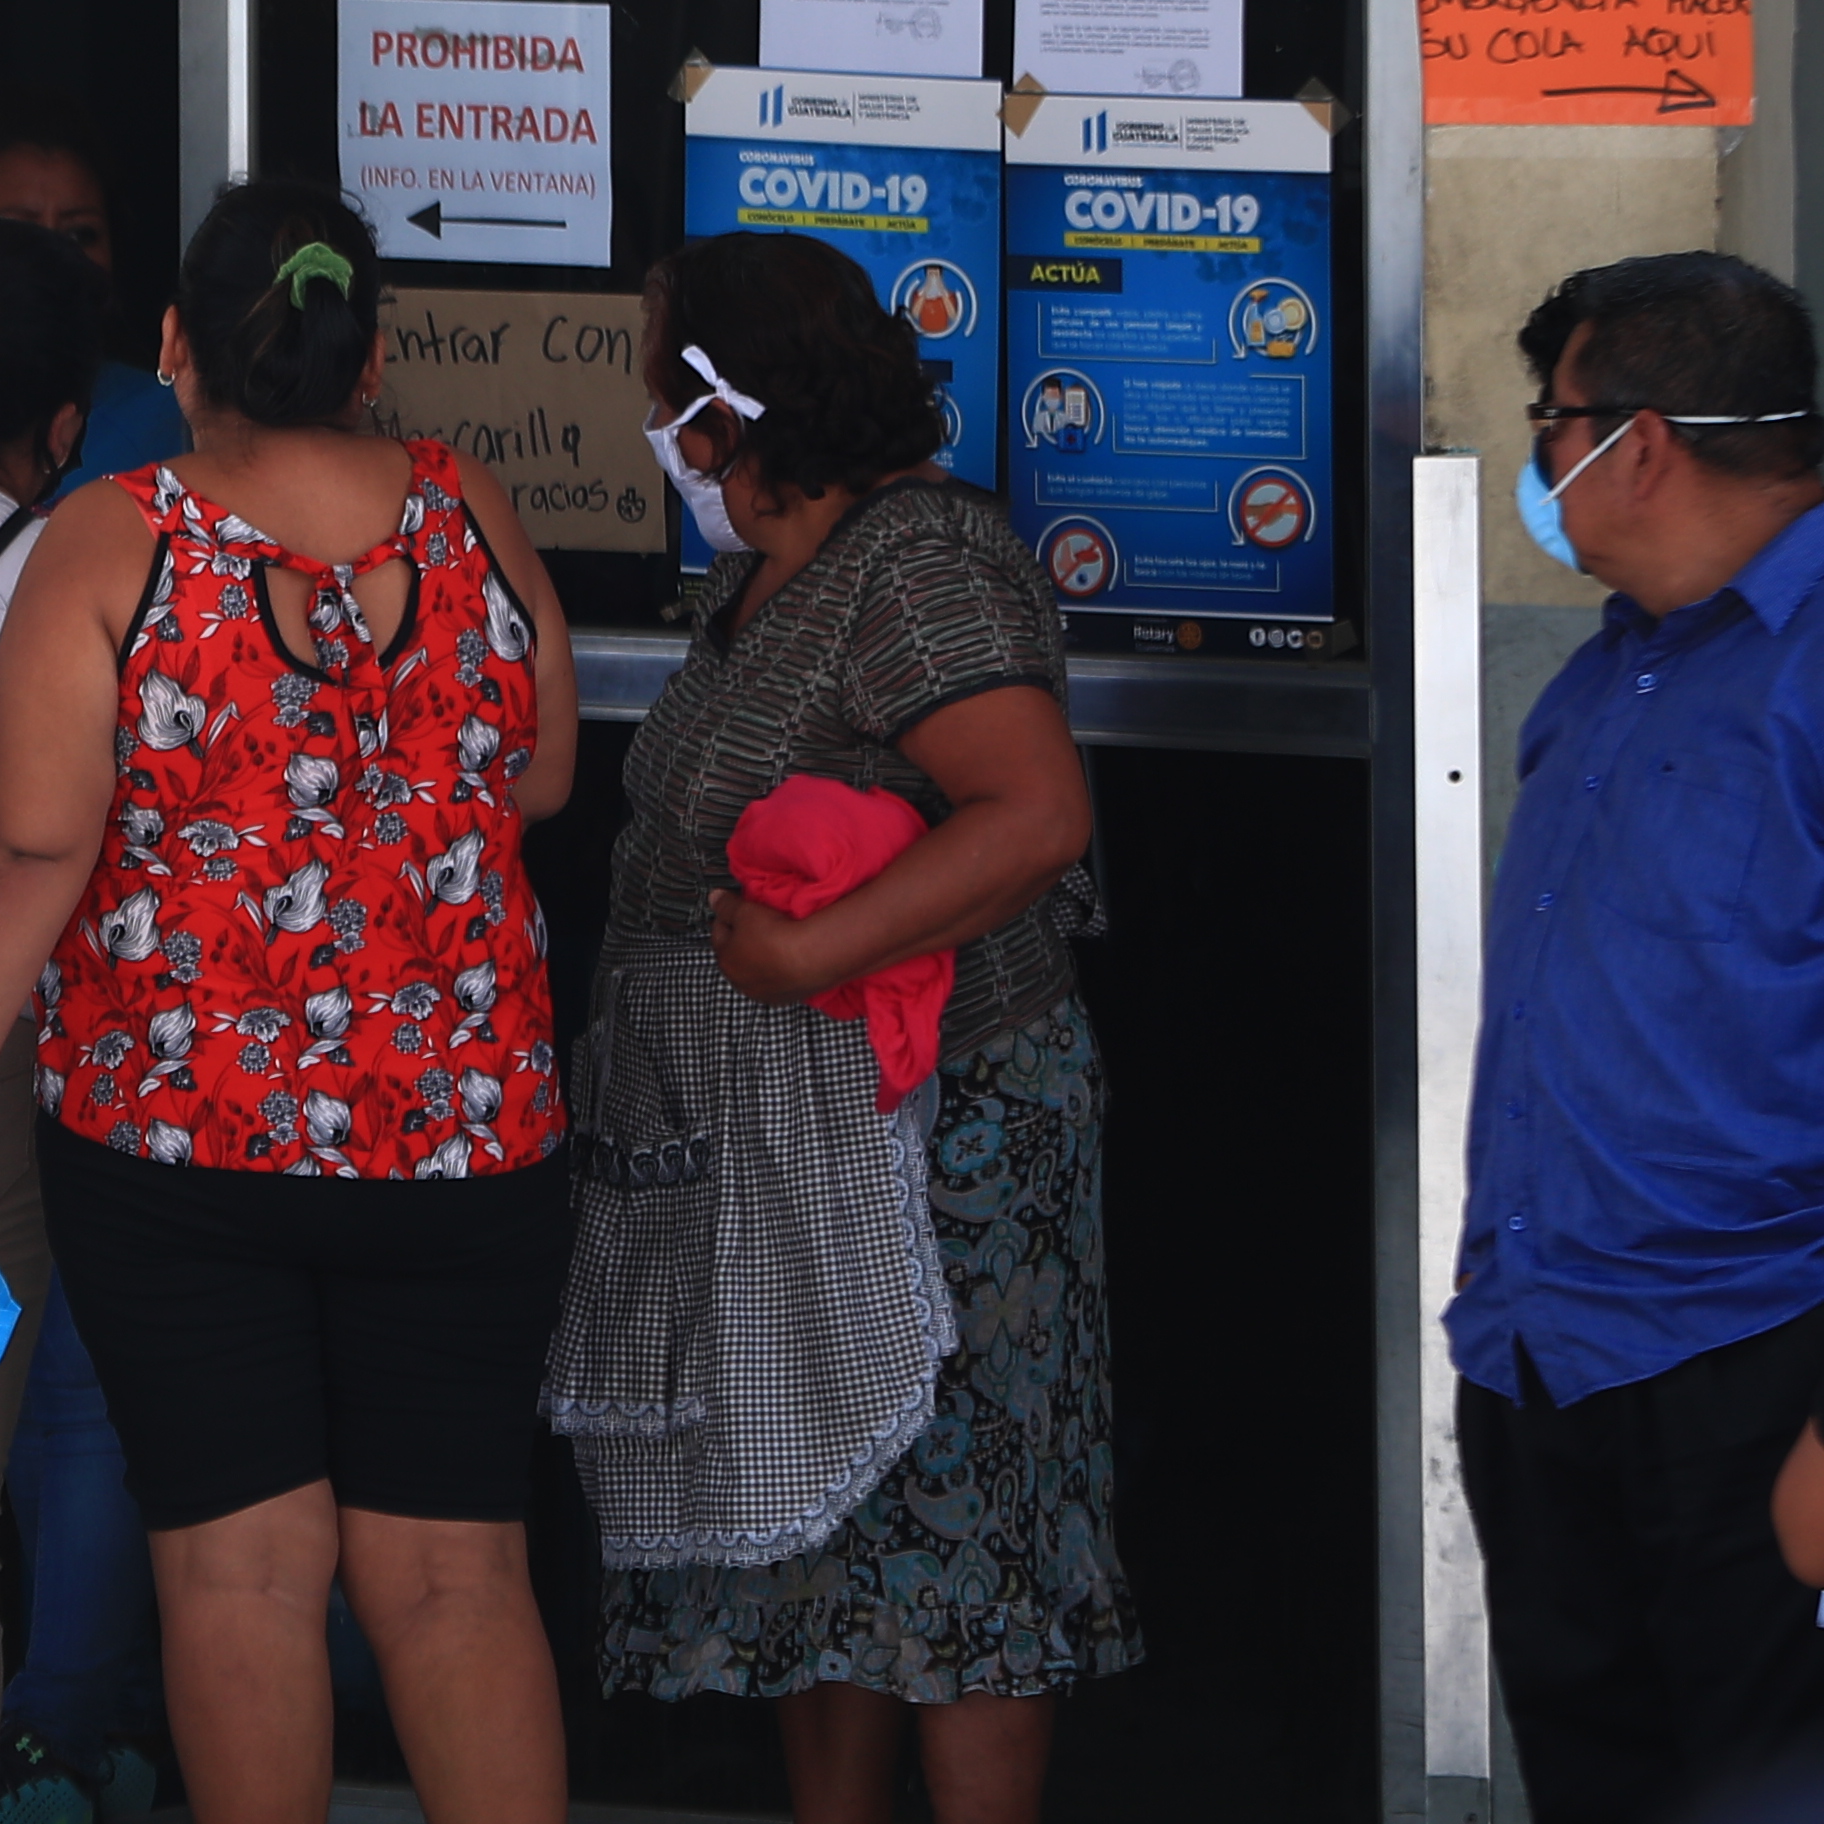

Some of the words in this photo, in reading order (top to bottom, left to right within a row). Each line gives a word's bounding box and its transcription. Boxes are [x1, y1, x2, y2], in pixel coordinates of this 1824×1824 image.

[371, 30, 584, 73] PROHIBIDA
[1421, 27, 1468, 60] SU
[1487, 27, 1584, 64] COLA
[358, 100, 403, 138] LA
[416, 103, 597, 144] ENTRADA
[739, 151, 814, 166] CORONAVIRUS
[360, 167, 422, 191] (INFO.
[429, 170, 455, 190] EN
[462, 171, 484, 191] LA
[490, 172, 596, 199] VENTANA)
[738, 167, 928, 213] COVID-19
[1064, 174, 1143, 188] CORONAVIRUS
[1064, 190, 1259, 234] COVID-19
[1030, 262, 1101, 284] ACTÚA
